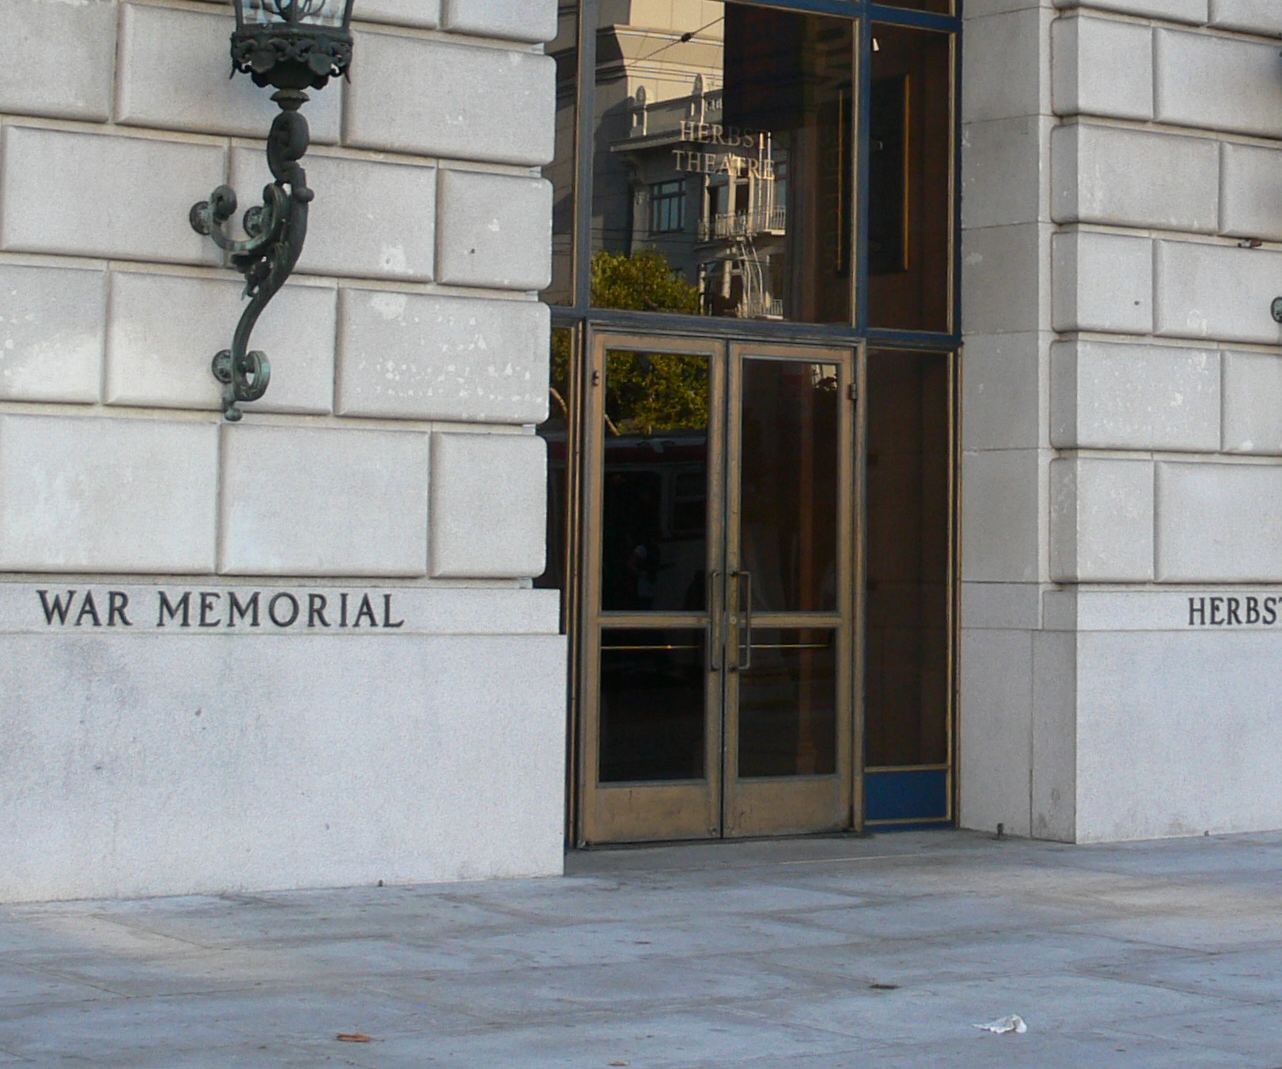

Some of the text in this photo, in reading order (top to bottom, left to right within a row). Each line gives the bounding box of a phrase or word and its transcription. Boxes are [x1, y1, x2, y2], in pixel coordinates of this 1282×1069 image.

[672, 149, 775, 180] THEATRE
[36, 589, 405, 628] WAR MEMORIAL
